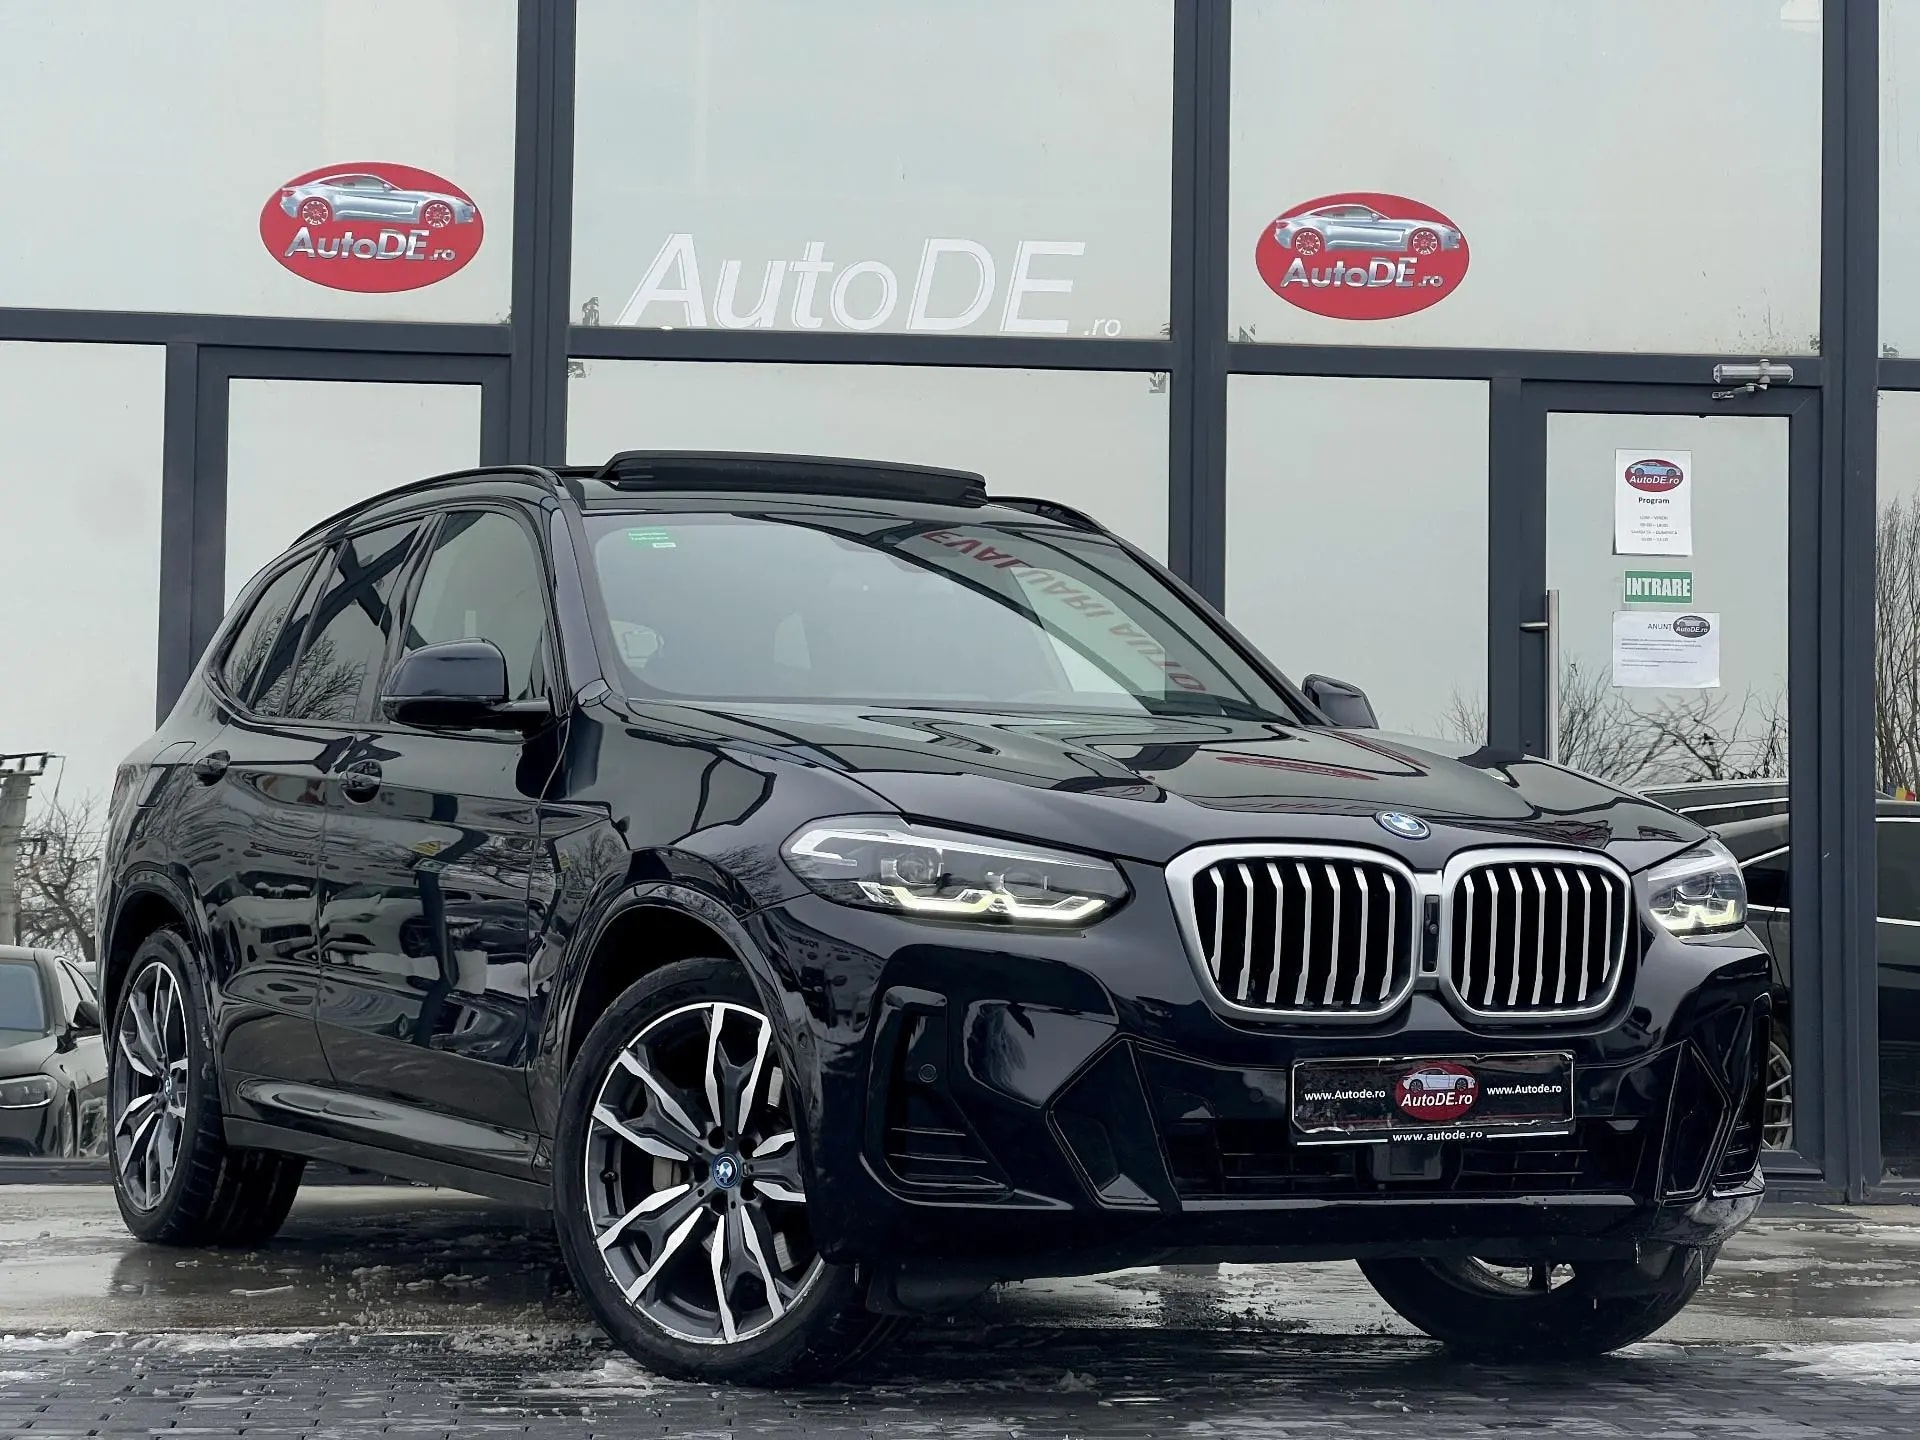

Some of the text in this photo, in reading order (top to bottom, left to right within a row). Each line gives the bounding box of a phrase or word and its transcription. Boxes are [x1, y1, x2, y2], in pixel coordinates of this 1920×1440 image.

[1629, 475, 1680, 485] AutoDE.ro
[1638, 496, 1670, 505] Program
[1626, 577, 1691, 597] INTRARE
[1304, 1088, 1386, 1101] www.Autode.ro
[1486, 1083, 1562, 1096] www.Autode.ro
[1401, 1091, 1473, 1107] AutoDE.ro
[1392, 1129, 1483, 1142] www.autode.ro
